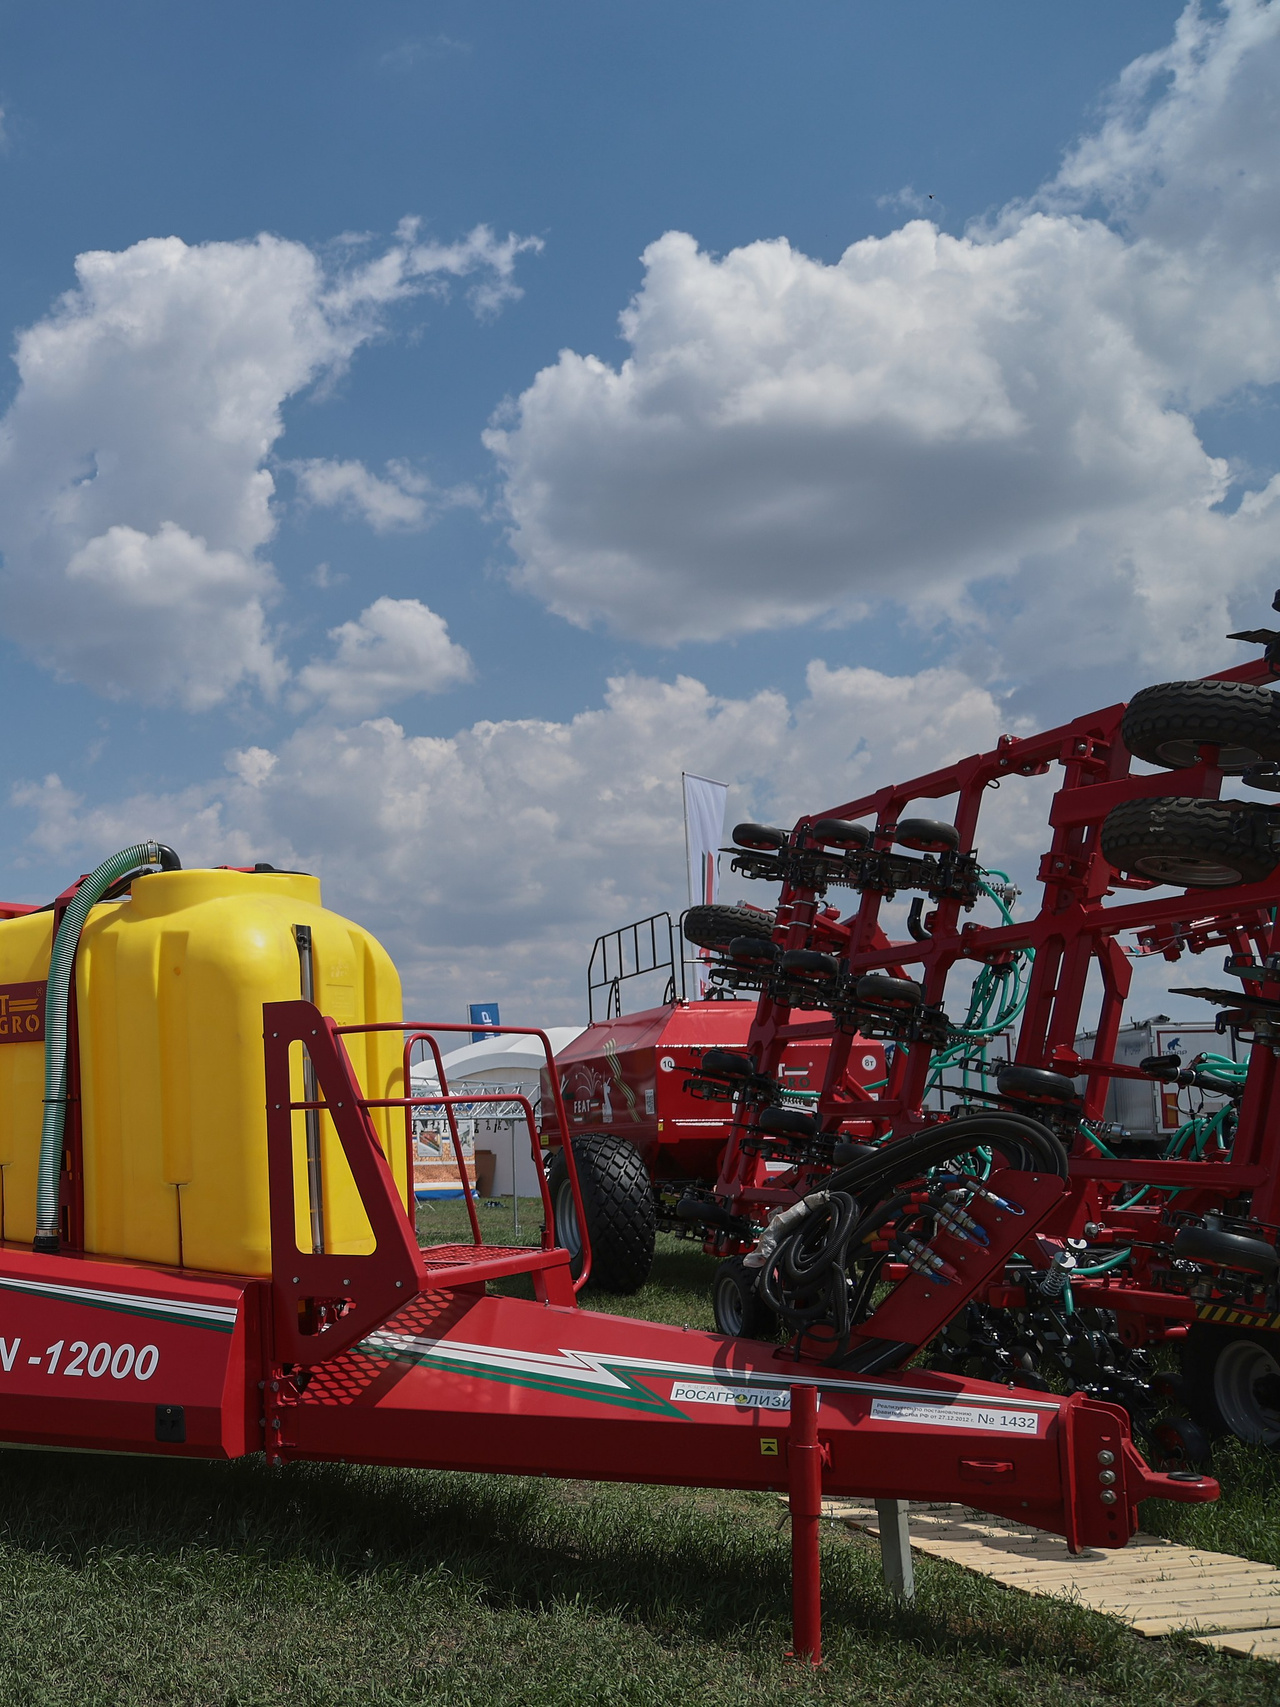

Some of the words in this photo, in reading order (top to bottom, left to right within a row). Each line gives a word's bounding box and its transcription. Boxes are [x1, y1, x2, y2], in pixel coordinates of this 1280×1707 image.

[574, 1099, 591, 1114] FEAT
[27, 1340, 160, 1381] -12000
[977, 1413, 995, 1425] №
[1000, 1415, 1035, 1429] 1432
